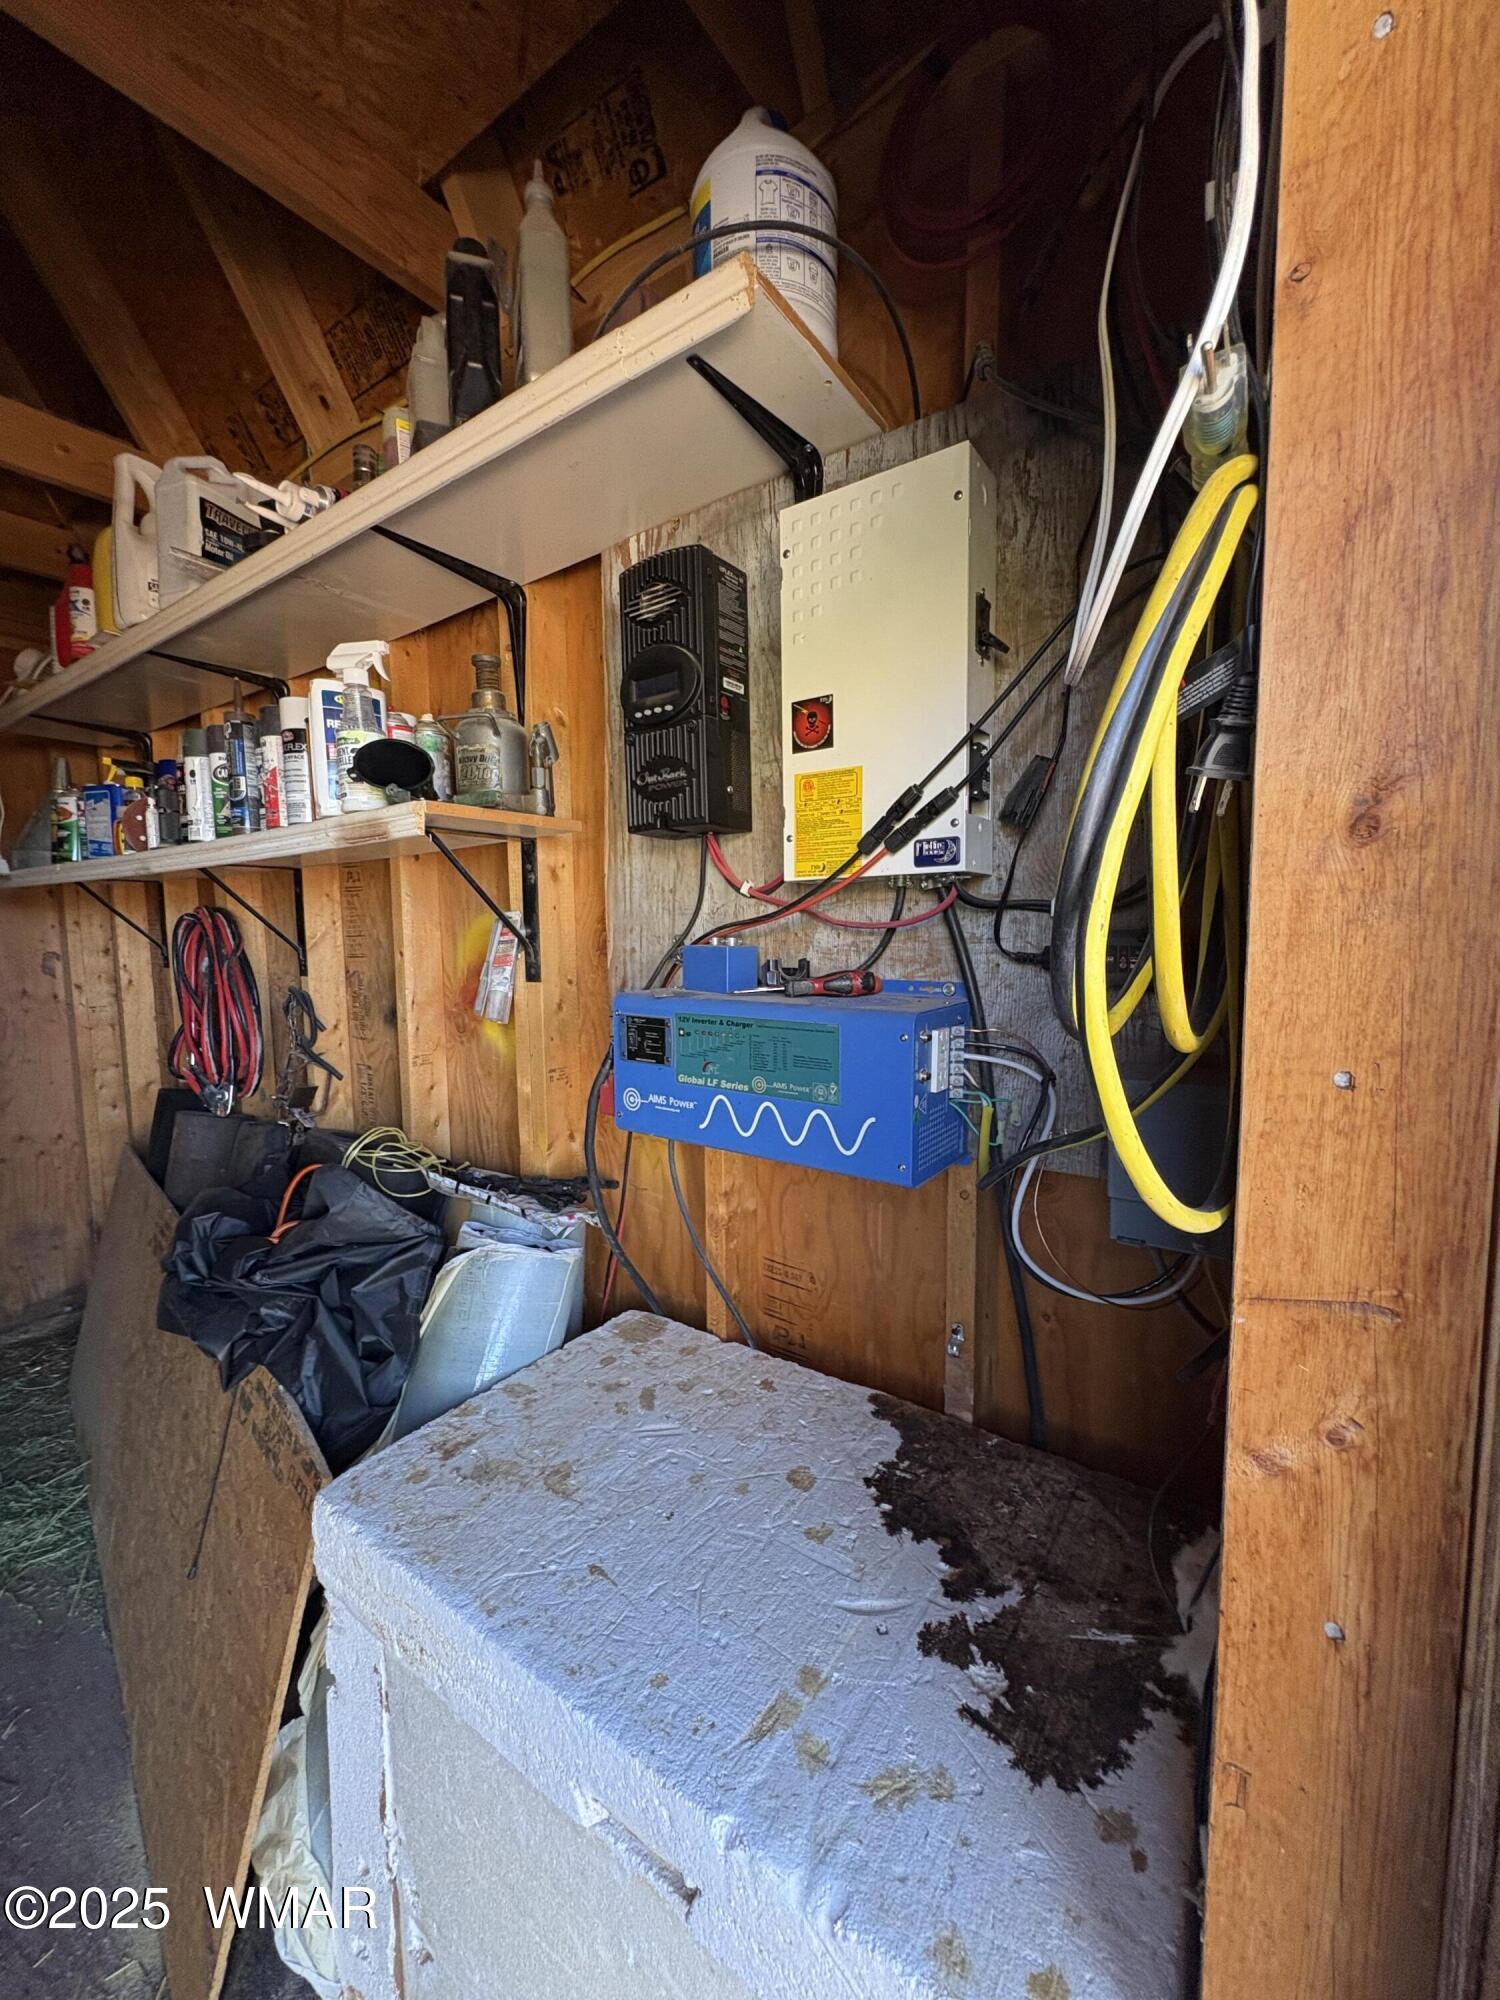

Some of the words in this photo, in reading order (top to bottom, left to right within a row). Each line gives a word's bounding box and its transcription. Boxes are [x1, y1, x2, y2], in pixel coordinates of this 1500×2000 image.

[692, 1017, 717, 1026] Inverter
[726, 1019, 754, 1030] Charger
[677, 1073, 705, 1086] Global
[707, 1078, 719, 1087] LF
[719, 1079, 749, 1092] Series
[647, 1093, 667, 1105] AIMS
